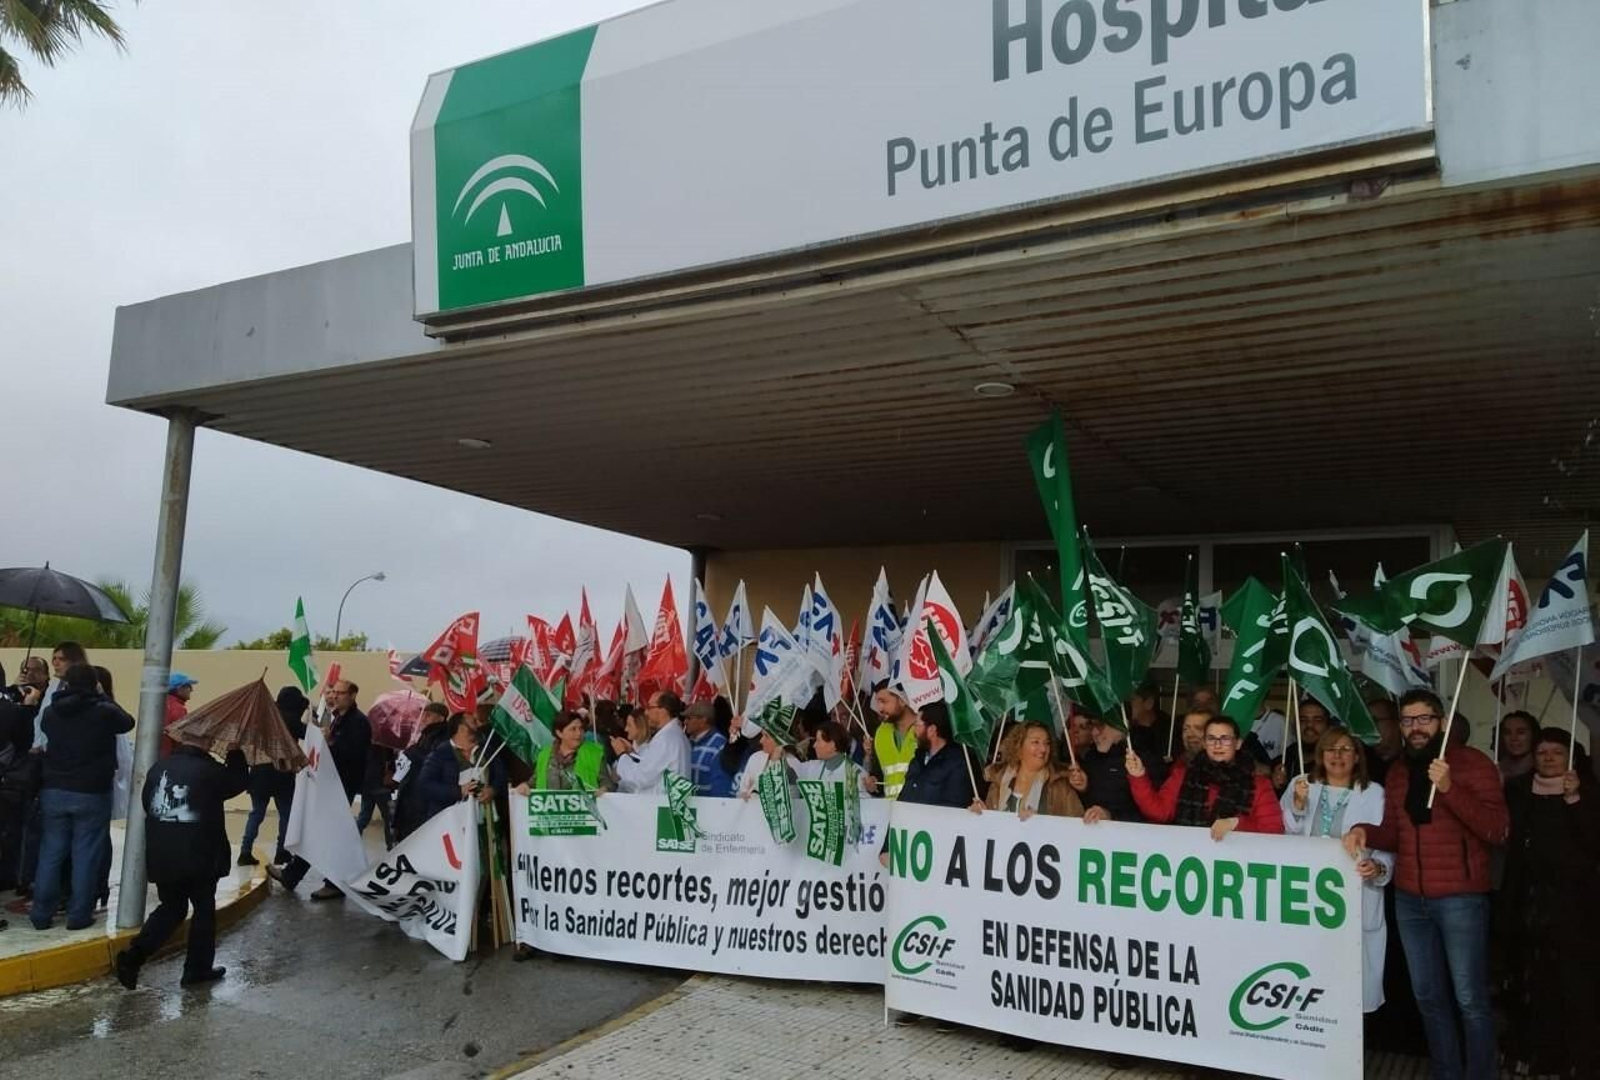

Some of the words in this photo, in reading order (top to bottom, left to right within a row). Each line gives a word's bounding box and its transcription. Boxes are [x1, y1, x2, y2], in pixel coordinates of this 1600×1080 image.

[993, 0, 1332, 82] Hosp
[887, 122, 1030, 196] Punta
[1048, 97, 1113, 161] de
[1134, 52, 1357, 144] Europa
[453, 250, 484, 271] JUNTA
[488, 246, 501, 263] DE
[505, 235, 563, 260] ANDALUCIA
[658, 838, 695, 851] SATSE
[701, 844, 714, 853] de
[802, 783, 827, 856] SATSE
[607, 865, 718, 913] recortes,
[726, 869, 791, 917] mejor
[796, 872, 885, 919] gestió
[890, 828, 933, 882] NO
[945, 836, 970, 888] A
[984, 839, 1061, 900] LOS
[1078, 848, 1346, 929] RECORTES
[521, 898, 539, 928] Por
[545, 904, 559, 931] la
[566, 906, 638, 940] Sanidad
[644, 912, 708, 946] Pública
[712, 925, 724, 955] y
[728, 922, 807, 953] nuestros
[983, 919, 1008, 958] EN
[1016, 924, 1119, 975] DEFENSA
[1127, 938, 1159, 980] DE
[1169, 943, 1200, 985] LA
[991, 970, 1084, 1020] SANIDAD
[1093, 978, 1198, 1038] PÚBLICA
